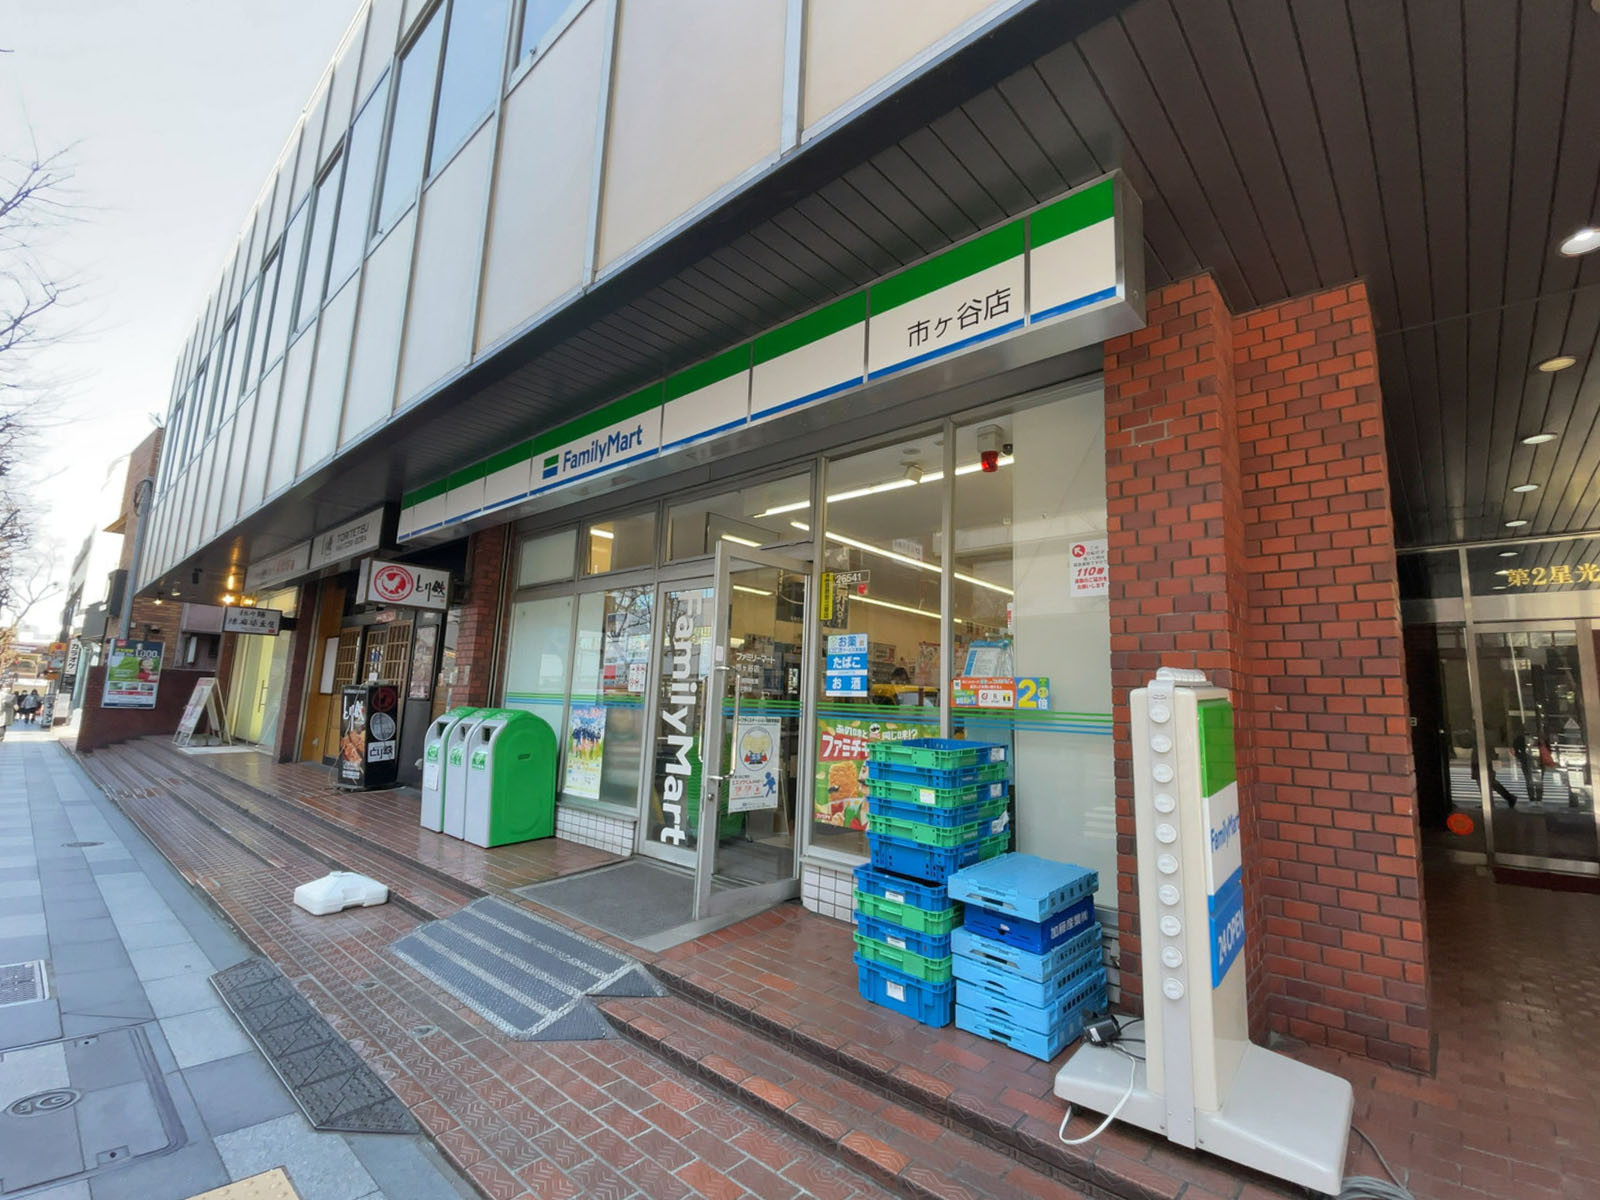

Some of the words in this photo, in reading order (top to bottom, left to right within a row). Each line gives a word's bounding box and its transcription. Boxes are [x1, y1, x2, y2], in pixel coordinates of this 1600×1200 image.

[907, 287, 1011, 347] 市ヶ谷店
[562, 424, 643, 472] FamilyMart
[1077, 566, 1104, 577] 110番
[67, 643, 79, 670] カラオケ
[736, 652, 776, 664] ファミリーマート
[832, 656, 861, 669] たばこ
[1018, 679, 1037, 709] 2
[660, 591, 703, 846] FamilyMart
